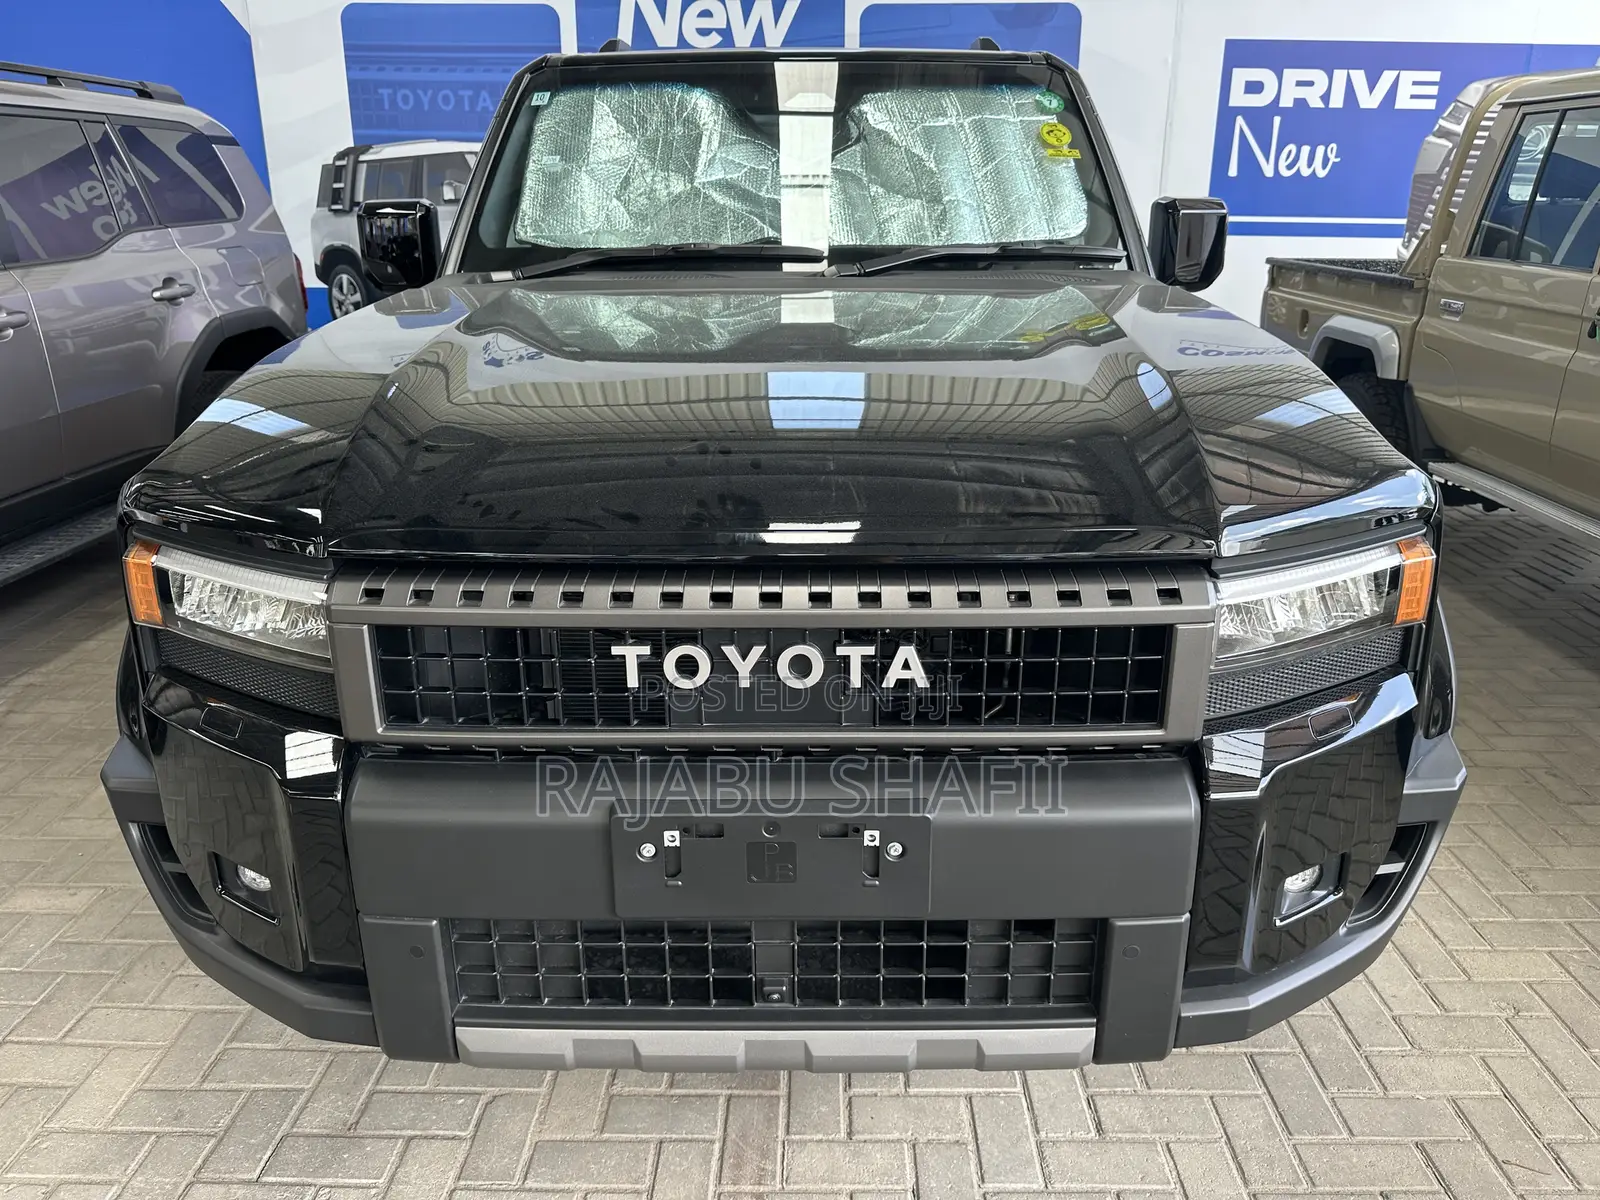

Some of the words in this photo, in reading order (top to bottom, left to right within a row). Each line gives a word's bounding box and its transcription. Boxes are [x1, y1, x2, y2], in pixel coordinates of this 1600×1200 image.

[616, 0, 801, 48] New
[377, 88, 495, 111] TOYOTA
[1228, 67, 1442, 110] DRIVE
[1227, 115, 1341, 179] New
[611, 645, 930, 690] TOYOTA
